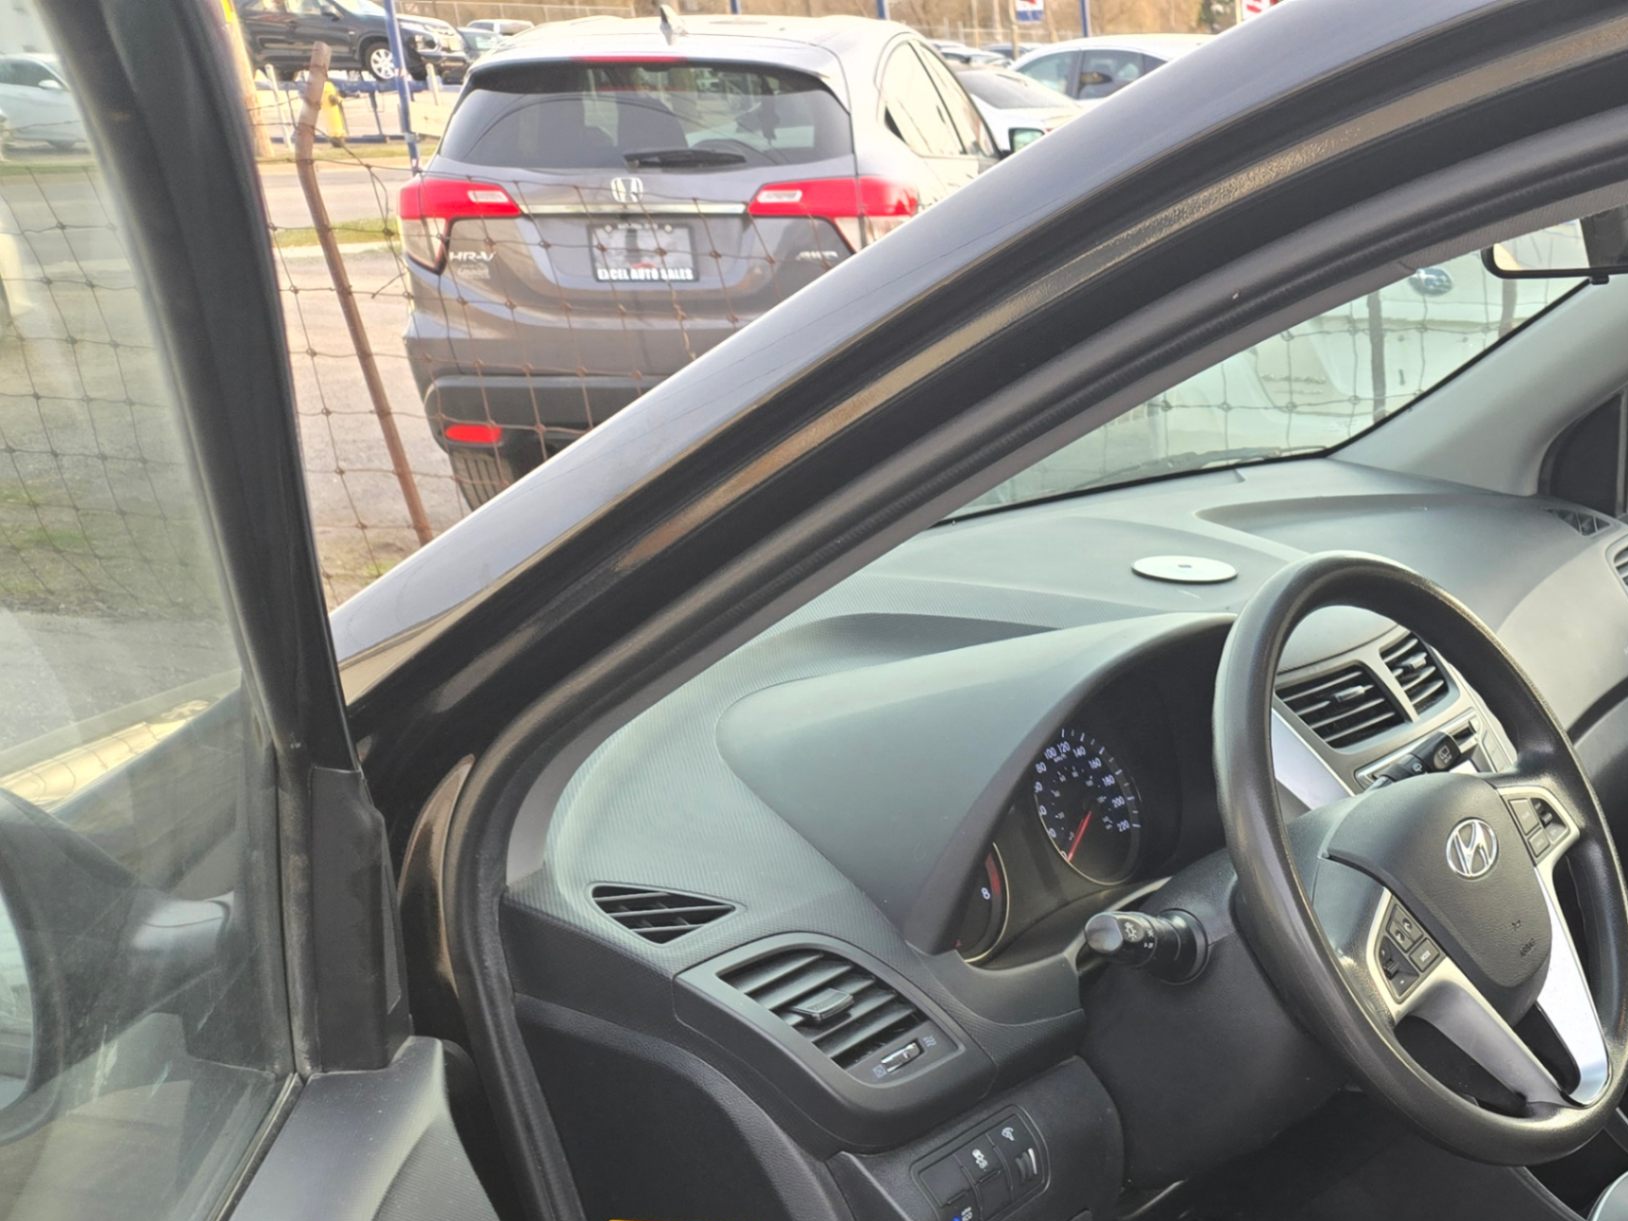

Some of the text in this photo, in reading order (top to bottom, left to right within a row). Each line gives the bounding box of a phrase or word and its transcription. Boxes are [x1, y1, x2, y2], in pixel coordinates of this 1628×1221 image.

[448, 251, 496, 262] HR-V
[631, 268, 659, 280] AUTO
[1117, 819, 1130, 832] 220
[981, 887, 991, 900] 8
